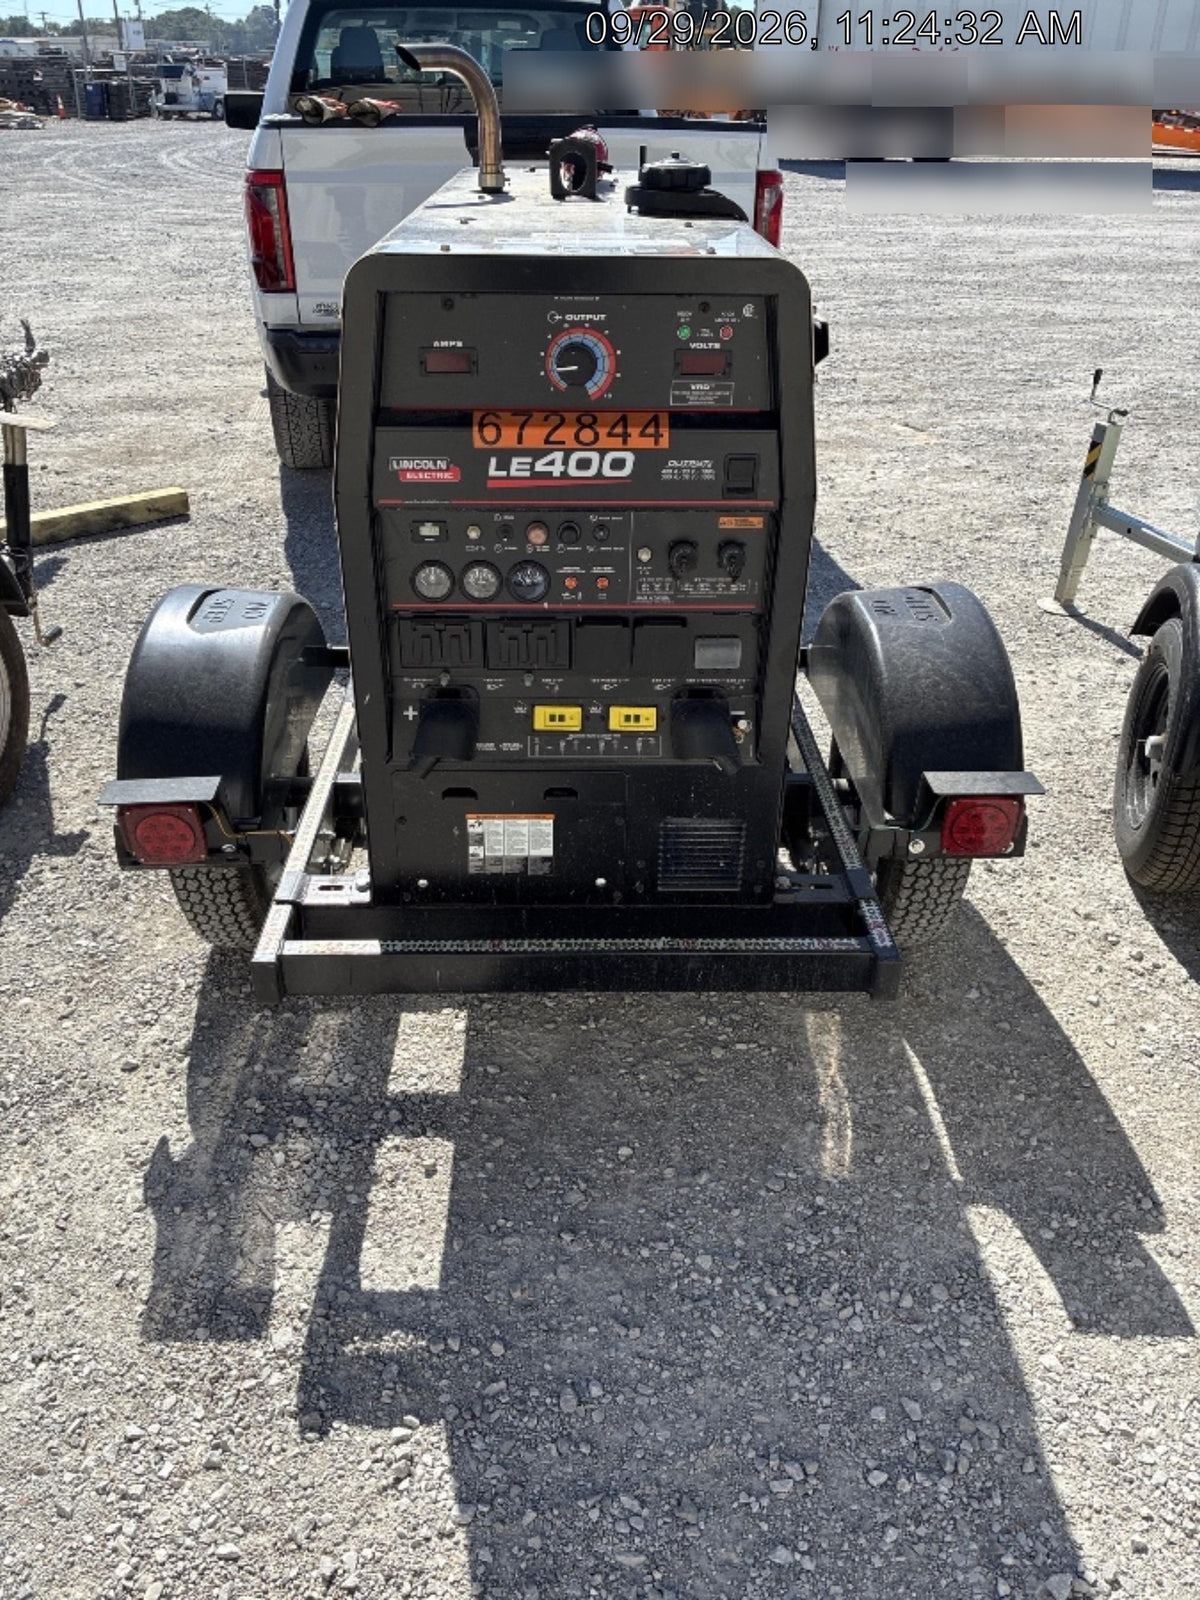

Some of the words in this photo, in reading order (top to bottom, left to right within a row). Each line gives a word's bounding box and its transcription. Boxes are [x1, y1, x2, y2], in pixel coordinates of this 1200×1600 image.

[565, 313, 607, 321] OUTPUT
[433, 340, 463, 348] AMPS
[477, 411, 664, 447] 672844
[391, 459, 448, 470] LINCOLN
[488, 450, 636, 478] LE400
[406, 470, 455, 479] ELECTRIC
